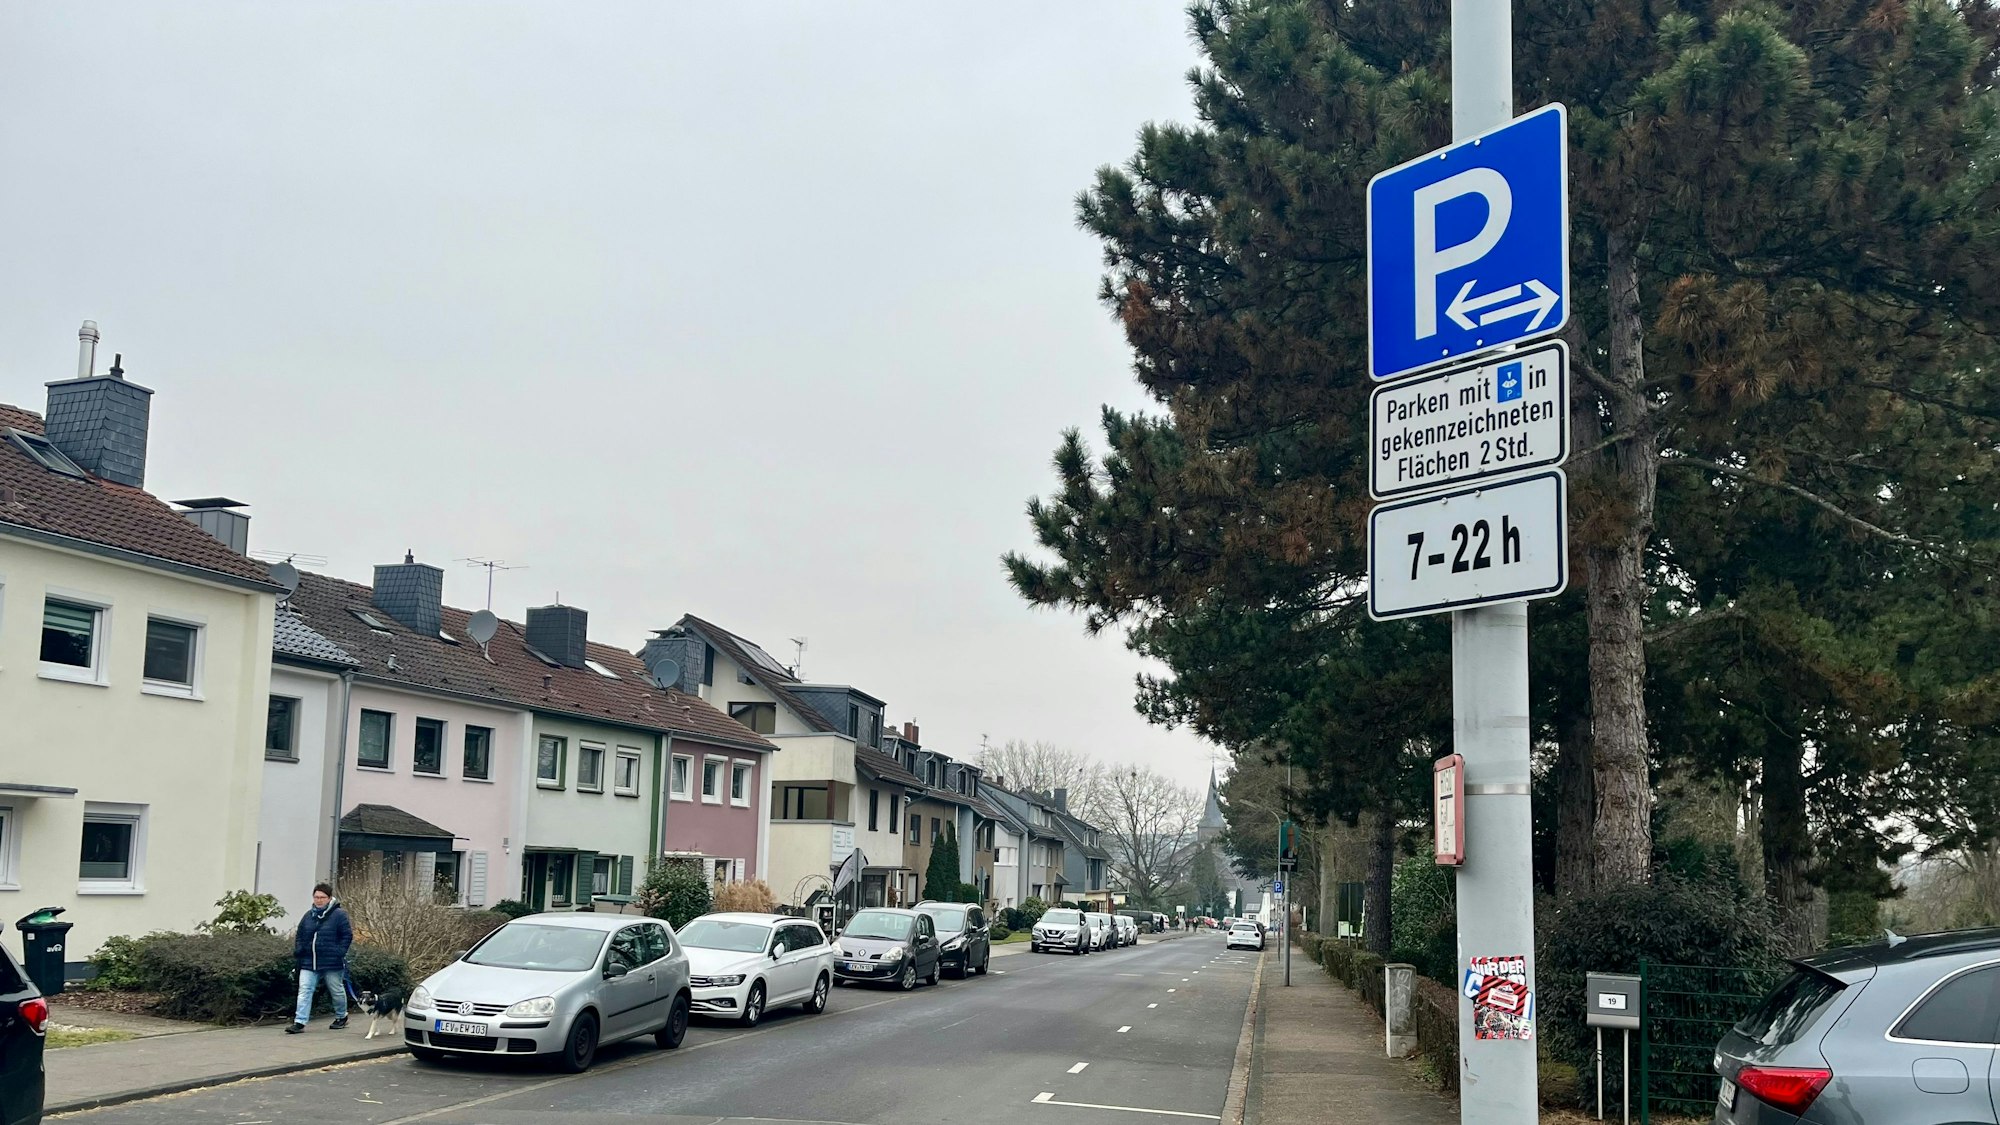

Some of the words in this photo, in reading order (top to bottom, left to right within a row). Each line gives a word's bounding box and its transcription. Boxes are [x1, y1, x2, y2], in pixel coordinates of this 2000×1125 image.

[1414, 167, 1513, 340] P
[1387, 393, 1449, 424] Parken
[1459, 377, 1491, 407] mit
[1529, 365, 1546, 390] in
[1381, 400, 1553, 461] gekennzeichneten
[1398, 450, 1470, 482] Flächen
[1480, 440, 1491, 466] 2
[1496, 432, 1534, 462] Std.
[1502, 514, 1521, 565] h
[1608, 997, 1617, 1005] 19
